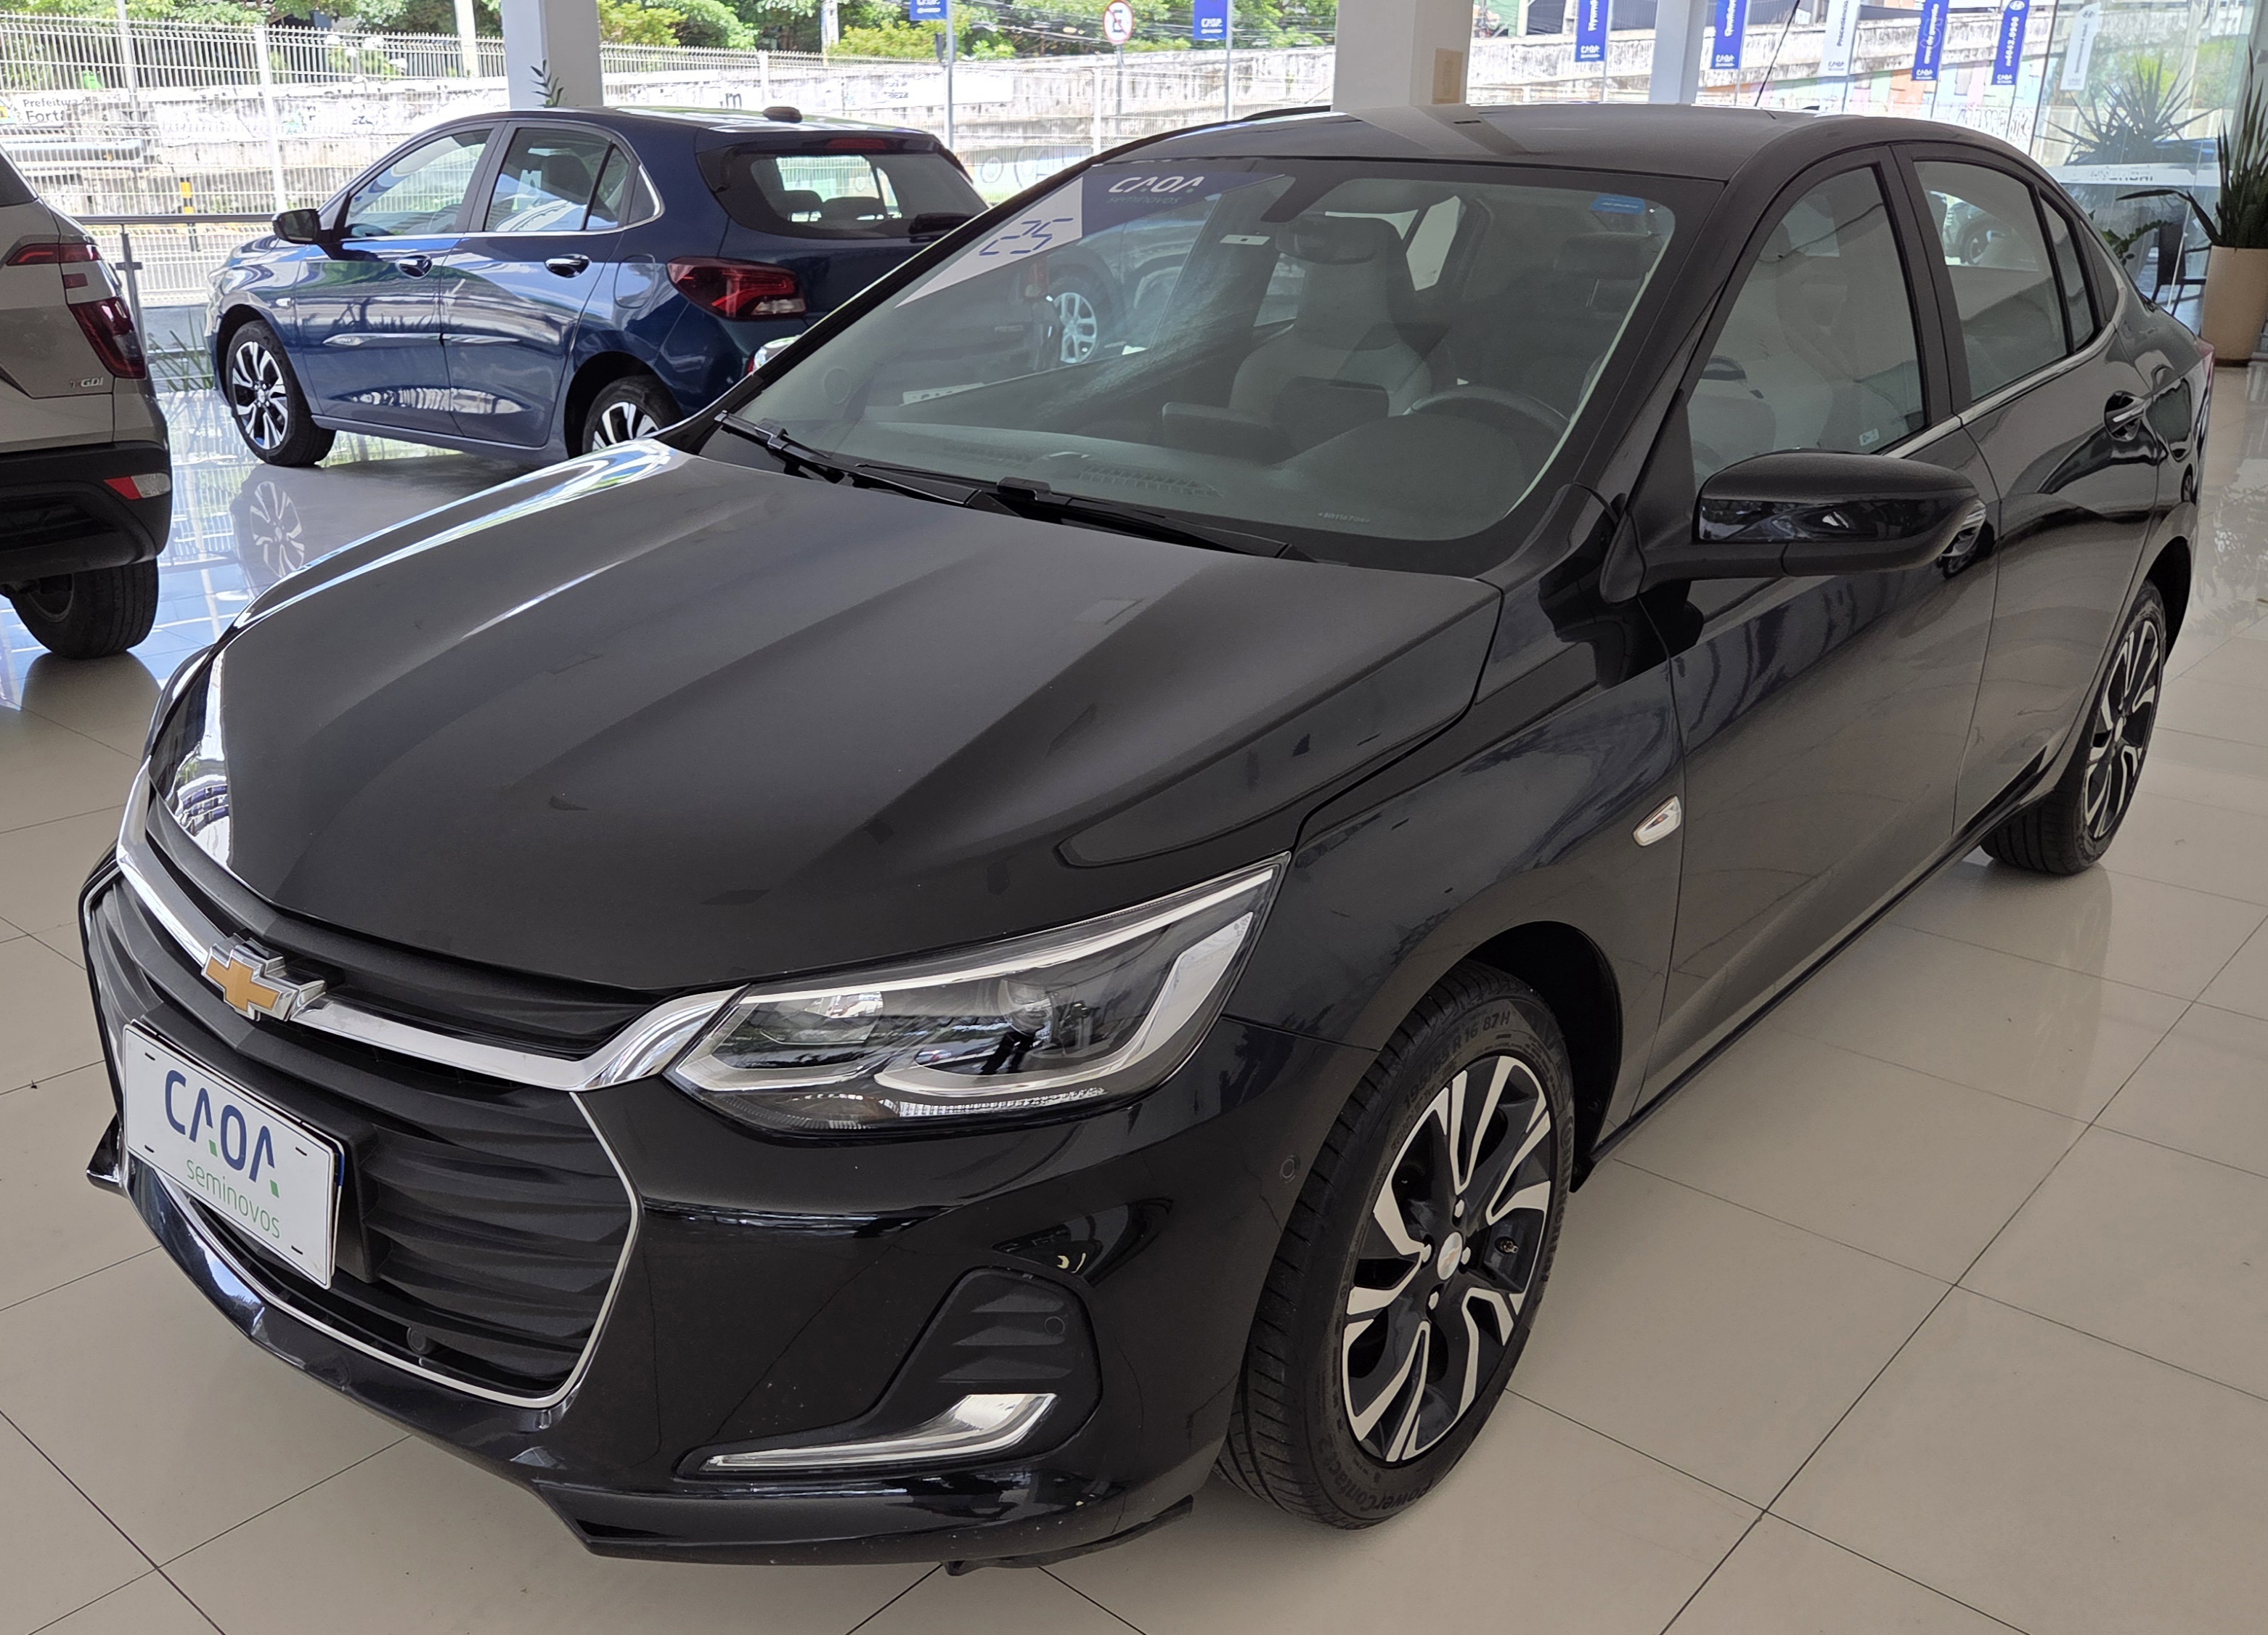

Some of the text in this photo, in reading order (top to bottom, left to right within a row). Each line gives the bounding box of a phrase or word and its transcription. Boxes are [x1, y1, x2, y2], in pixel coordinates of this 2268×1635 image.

[1109, 176, 1204, 193] CAOA
[165, 1069, 280, 1199] CAOA
[186, 1159, 280, 1239] seminovos
